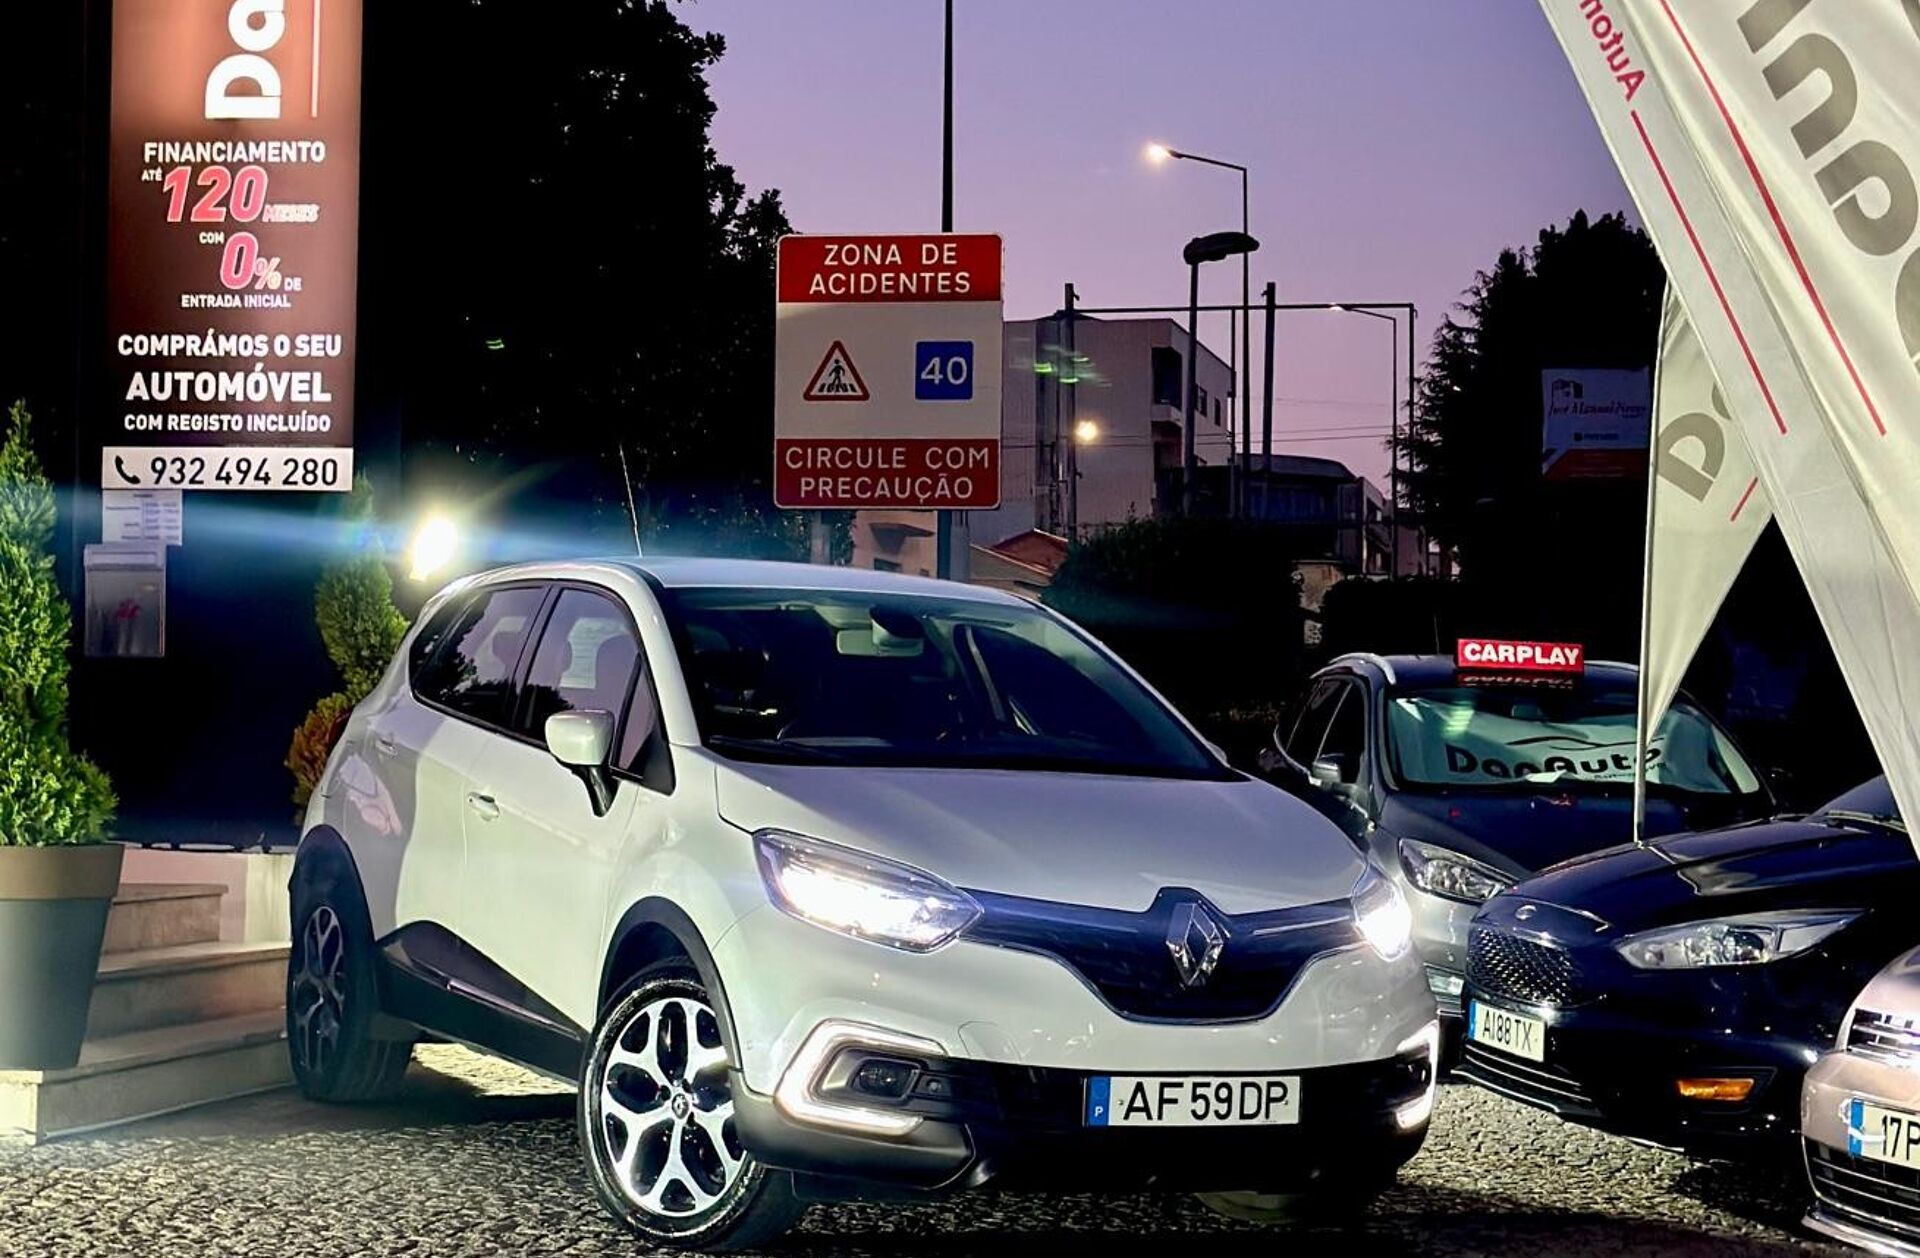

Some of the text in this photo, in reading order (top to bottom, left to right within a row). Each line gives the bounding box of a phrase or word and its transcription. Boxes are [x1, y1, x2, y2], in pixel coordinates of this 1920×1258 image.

[144, 141, 326, 163] FINANCIAMENTO
[141, 167, 162, 181] ATÉ
[163, 165, 268, 222] 120
[199, 232, 302, 291] COM 0% DE
[824, 244, 957, 266] ZONA DE
[809, 271, 970, 295] ACIDENTES
[181, 294, 292, 308] ENTRADA INICIAL
[118, 328, 342, 358] COMPRÁMOS O SEU
[126, 363, 332, 402] AUTOMÓVEL
[920, 356, 967, 385] 40
[124, 410, 331, 433] COM REGISTO INCLUÍDO
[785, 446, 989, 470] CIRCULE COM
[150, 457, 338, 486] 932 494 280
[801, 473, 973, 504] PRECAUÇÃO
[1463, 642, 1579, 665] CARPLAY
[1094, 1105, 1104, 1118] P
